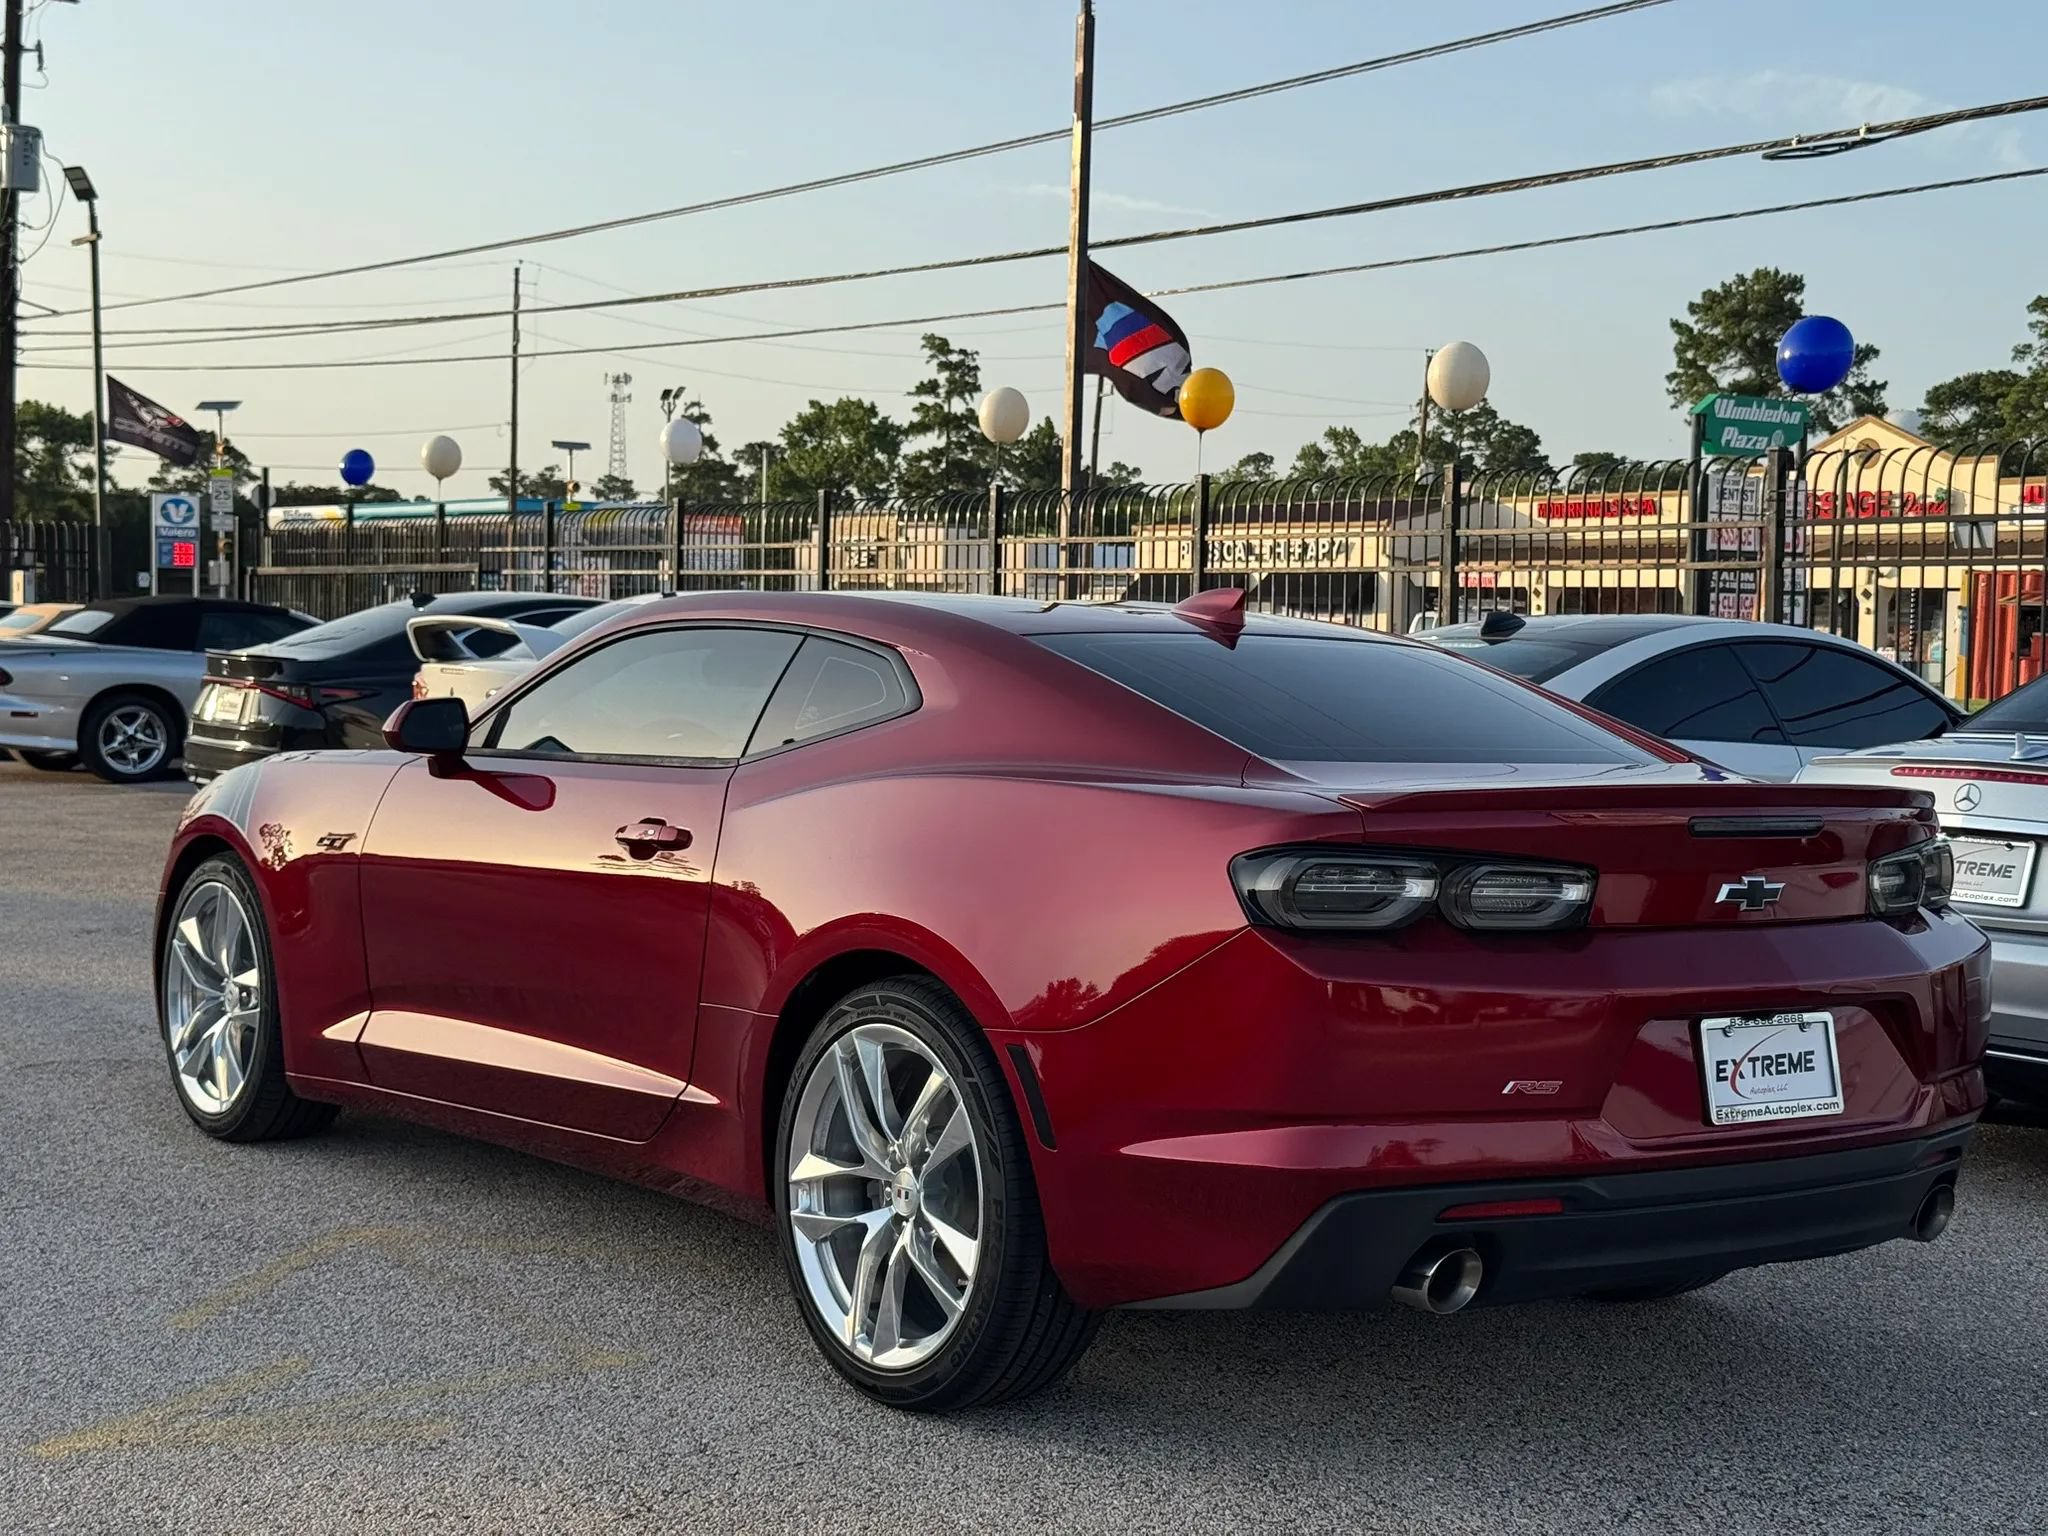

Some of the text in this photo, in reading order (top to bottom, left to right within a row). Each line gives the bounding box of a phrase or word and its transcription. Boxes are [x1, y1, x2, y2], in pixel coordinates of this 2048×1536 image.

[1713, 397, 1803, 425] Wimbledon
[1720, 425, 1769, 450] Plaza
[214, 489, 231, 501] 25
[1715, 487, 1755, 502] ENTST
[1586, 499, 1619, 518] NALS
[159, 527, 196, 538] Valero
[1721, 595, 1754, 610] CLIICA
[1955, 860, 2016, 879] TREME
[1951, 890, 2019, 904] Autoplex.com
[1715, 1050, 1816, 1083] EXTREME
[1501, 1080, 1563, 1095] RS
[1716, 1101, 1840, 1121] ExtremeAutoplex.com
